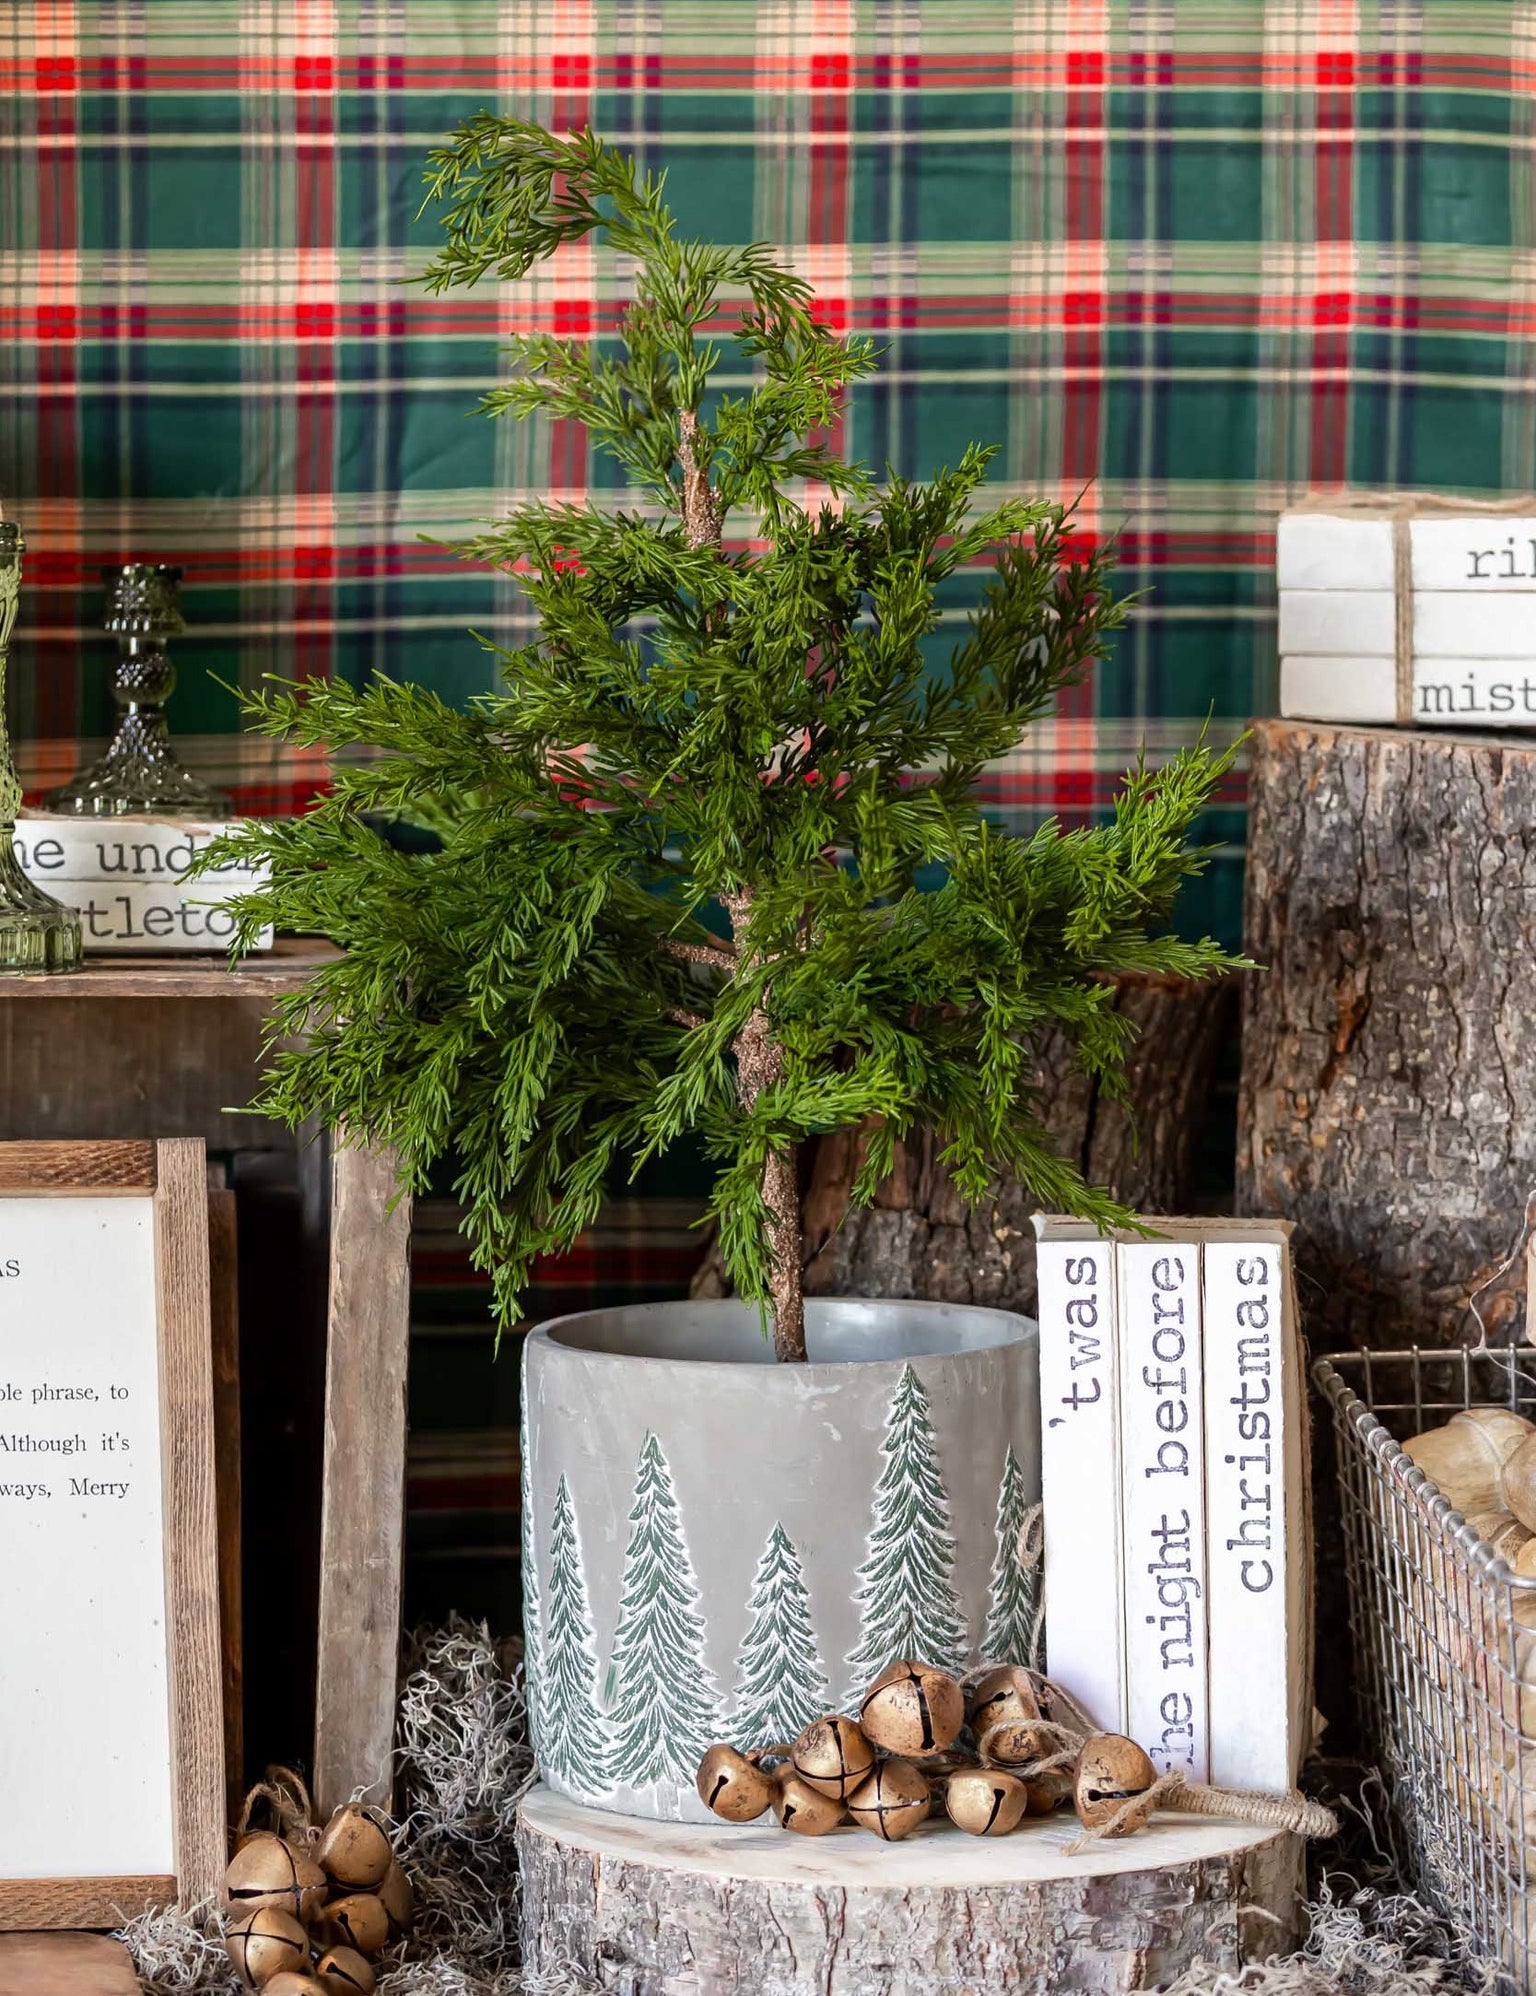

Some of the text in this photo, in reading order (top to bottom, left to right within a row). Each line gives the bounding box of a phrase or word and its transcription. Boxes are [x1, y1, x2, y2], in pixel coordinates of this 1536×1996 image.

[1466, 536, 1536, 579] ri
[0, 1258, 21, 1278] S
[1048, 1256, 1101, 1428] 'twas
[31, 1382, 99, 1405] phrase,
[110, 1383, 130, 1401] to
[1224, 1256, 1274, 1593] christmas
[0, 1431, 131, 1456] Although it's
[68, 1477, 131, 1499] Merry
[1142, 1257, 1202, 1773] he night before
